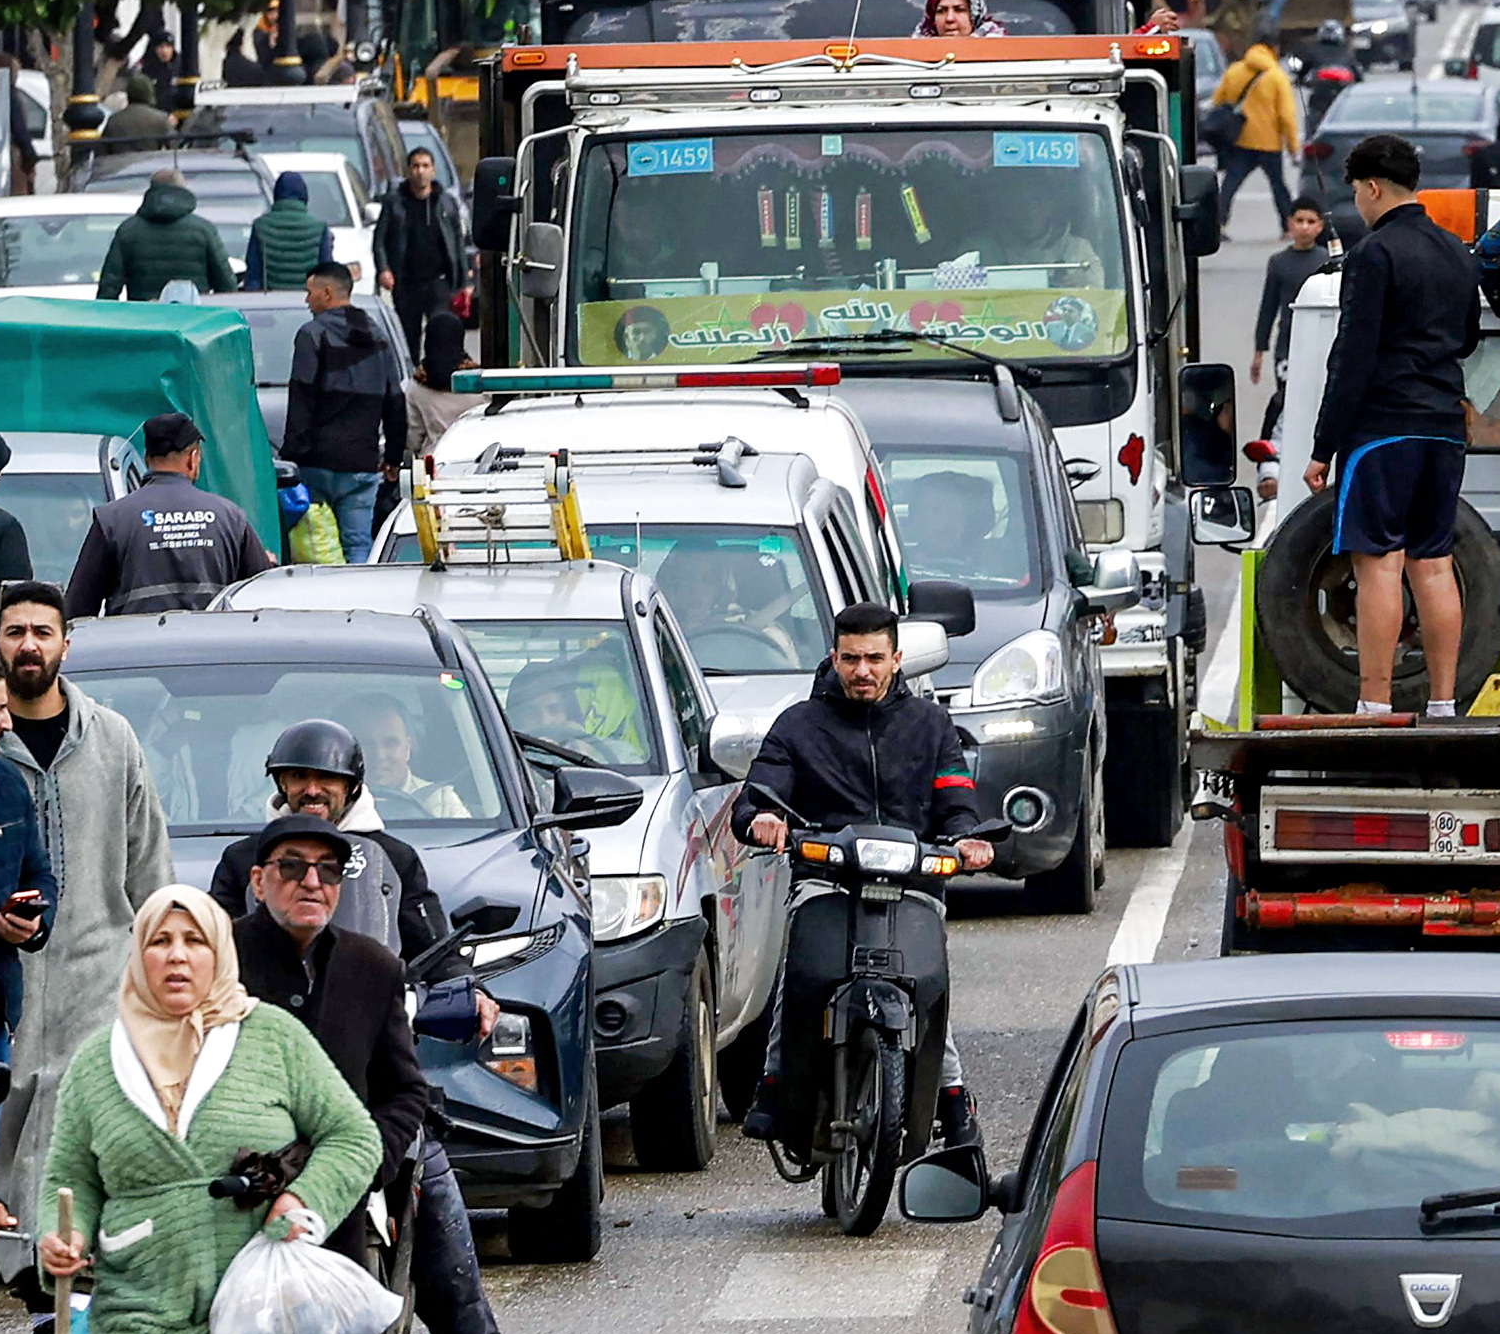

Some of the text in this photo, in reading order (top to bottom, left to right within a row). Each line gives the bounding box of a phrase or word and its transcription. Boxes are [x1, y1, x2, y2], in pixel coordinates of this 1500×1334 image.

[658, 148, 710, 169] 1459
[1026, 140, 1076, 163] 1459
[821, 298, 894, 323] الله
[154, 511, 216, 525] SARABO
[1437, 816, 1454, 830] 80
[1436, 838, 1453, 853] 90
[1409, 1283, 1452, 1293] DACIA
